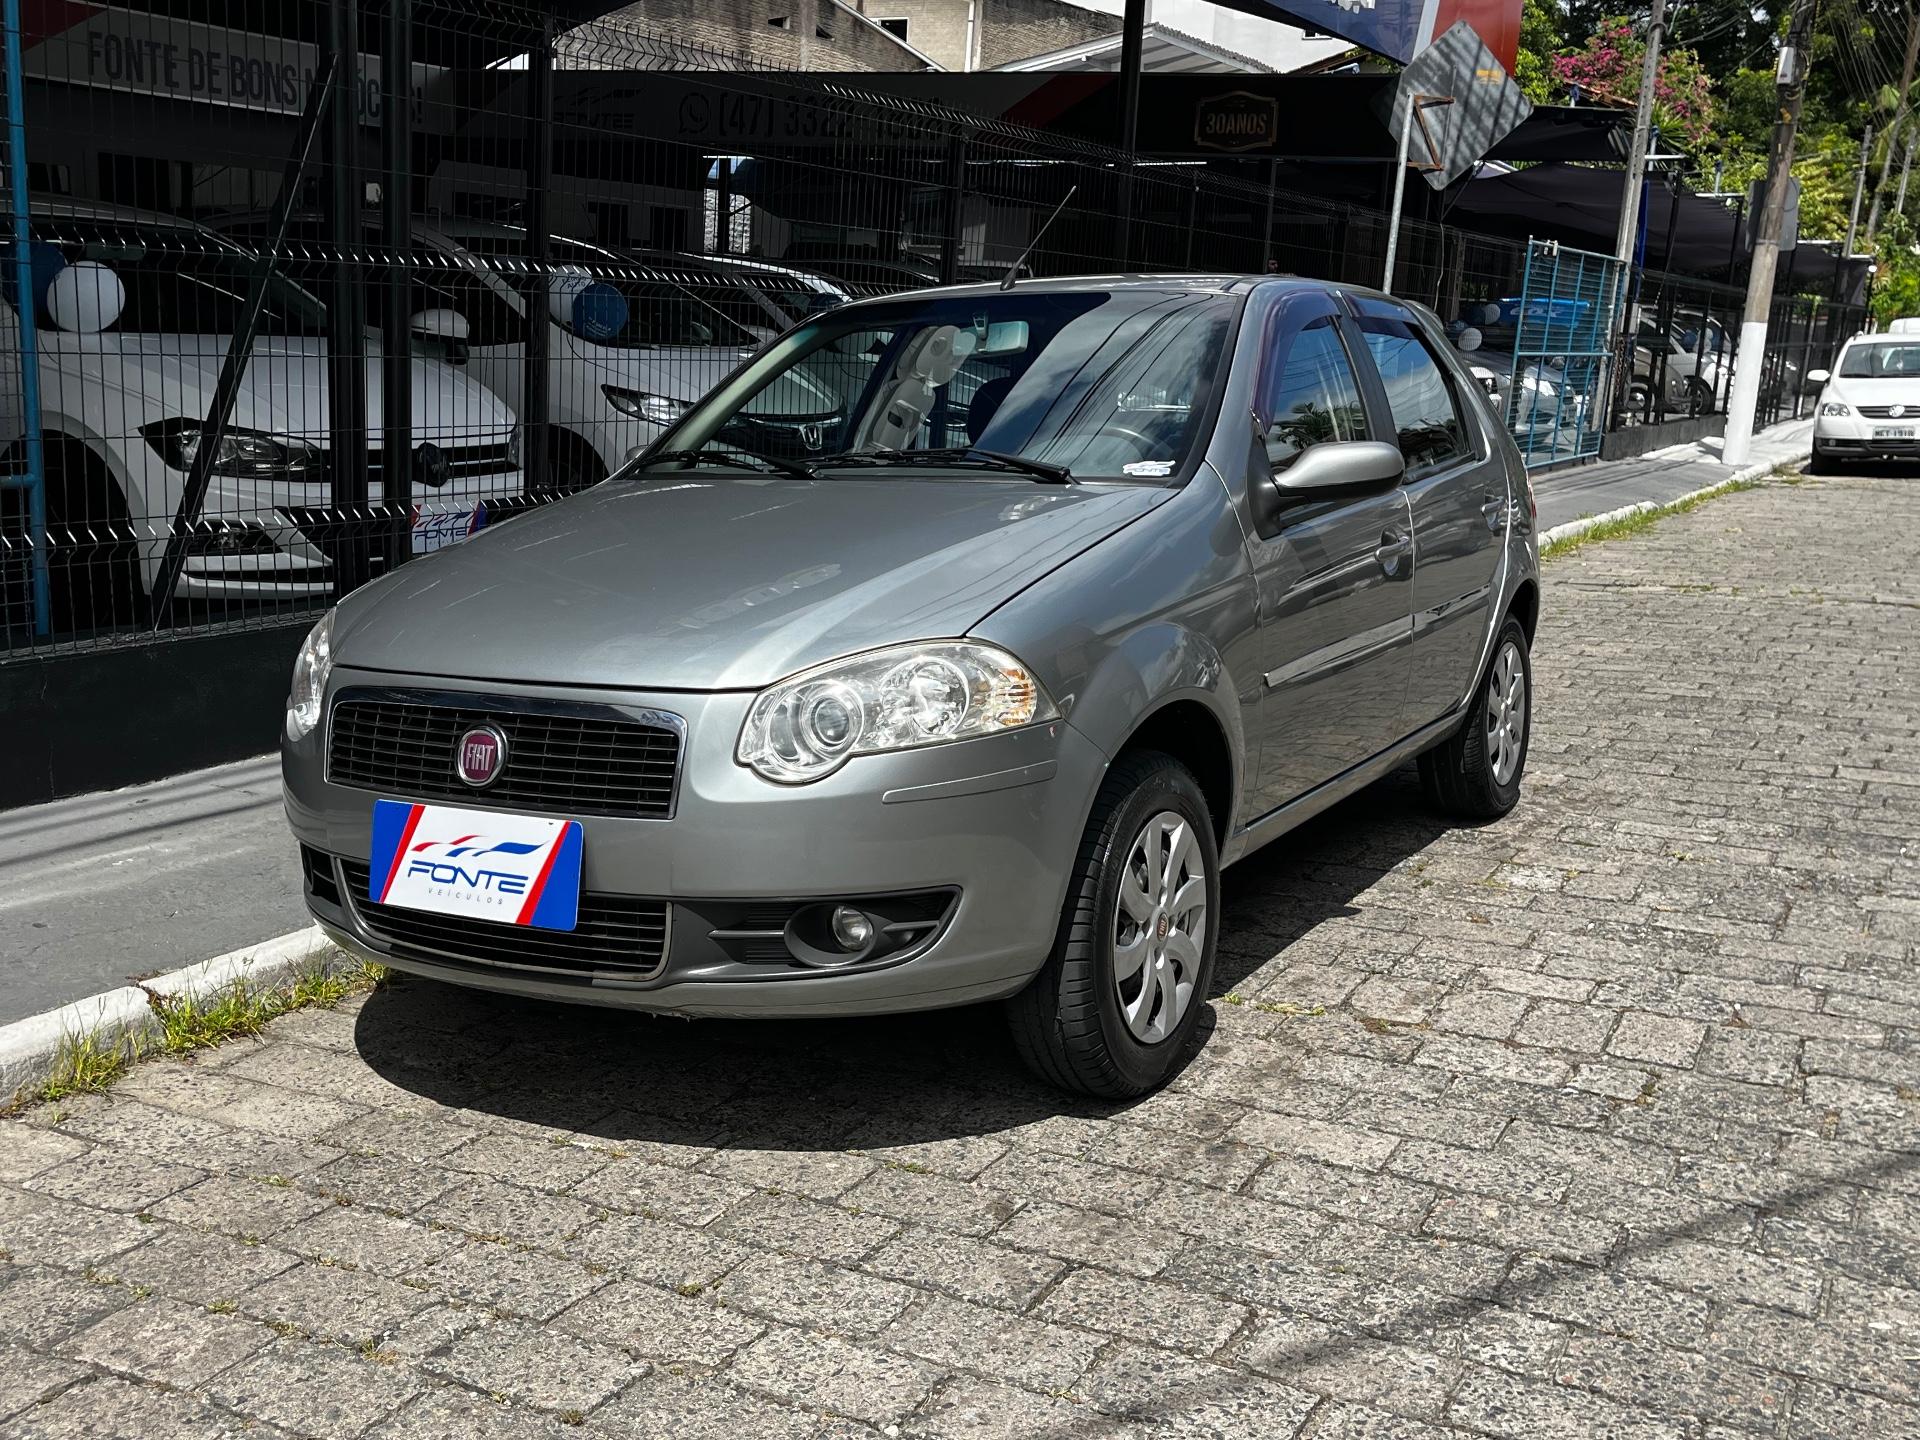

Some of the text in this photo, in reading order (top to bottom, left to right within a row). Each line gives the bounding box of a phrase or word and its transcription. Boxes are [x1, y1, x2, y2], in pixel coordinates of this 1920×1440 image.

[87, 31, 180, 88] FONTE
[188, 48, 223, 95] DE
[230, 54, 298, 106] BONS
[464, 743, 495, 771] FIAT
[407, 860, 530, 895] FONTE
